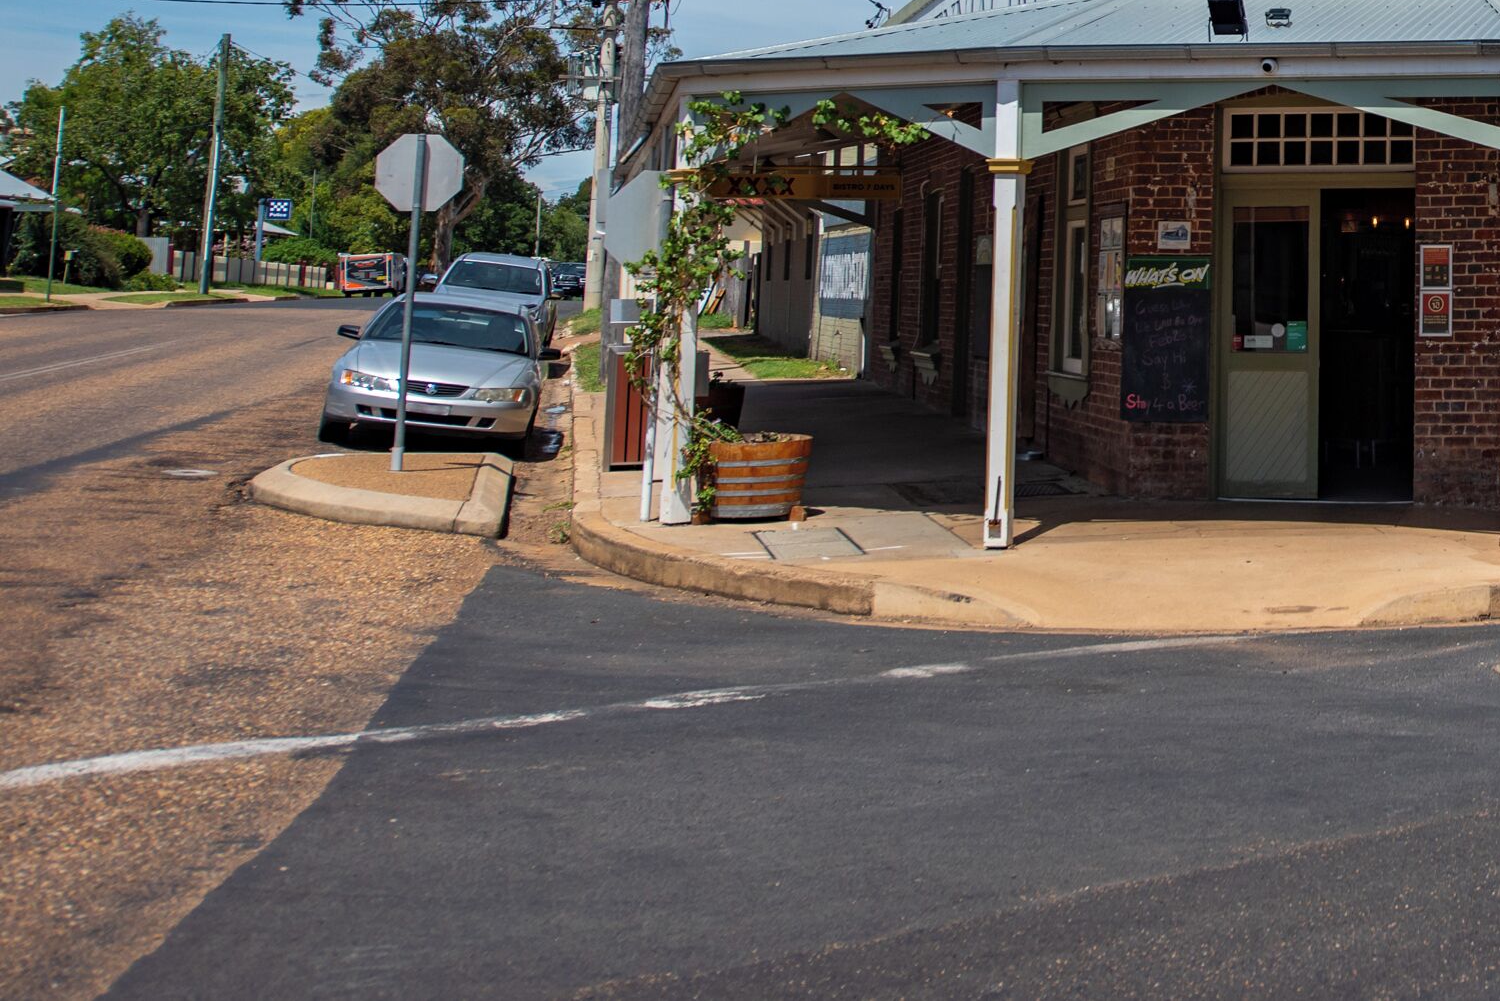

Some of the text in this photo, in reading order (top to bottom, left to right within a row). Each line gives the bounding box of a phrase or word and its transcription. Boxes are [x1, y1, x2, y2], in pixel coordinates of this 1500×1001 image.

[832, 183, 864, 191] BISTRO
[874, 183, 895, 191] DAYS
[1124, 262, 1210, 285] WHAT'S ON
[1141, 349, 1168, 371] Say
[1125, 393, 1150, 415] Stay
[1152, 397, 1165, 412] 4
